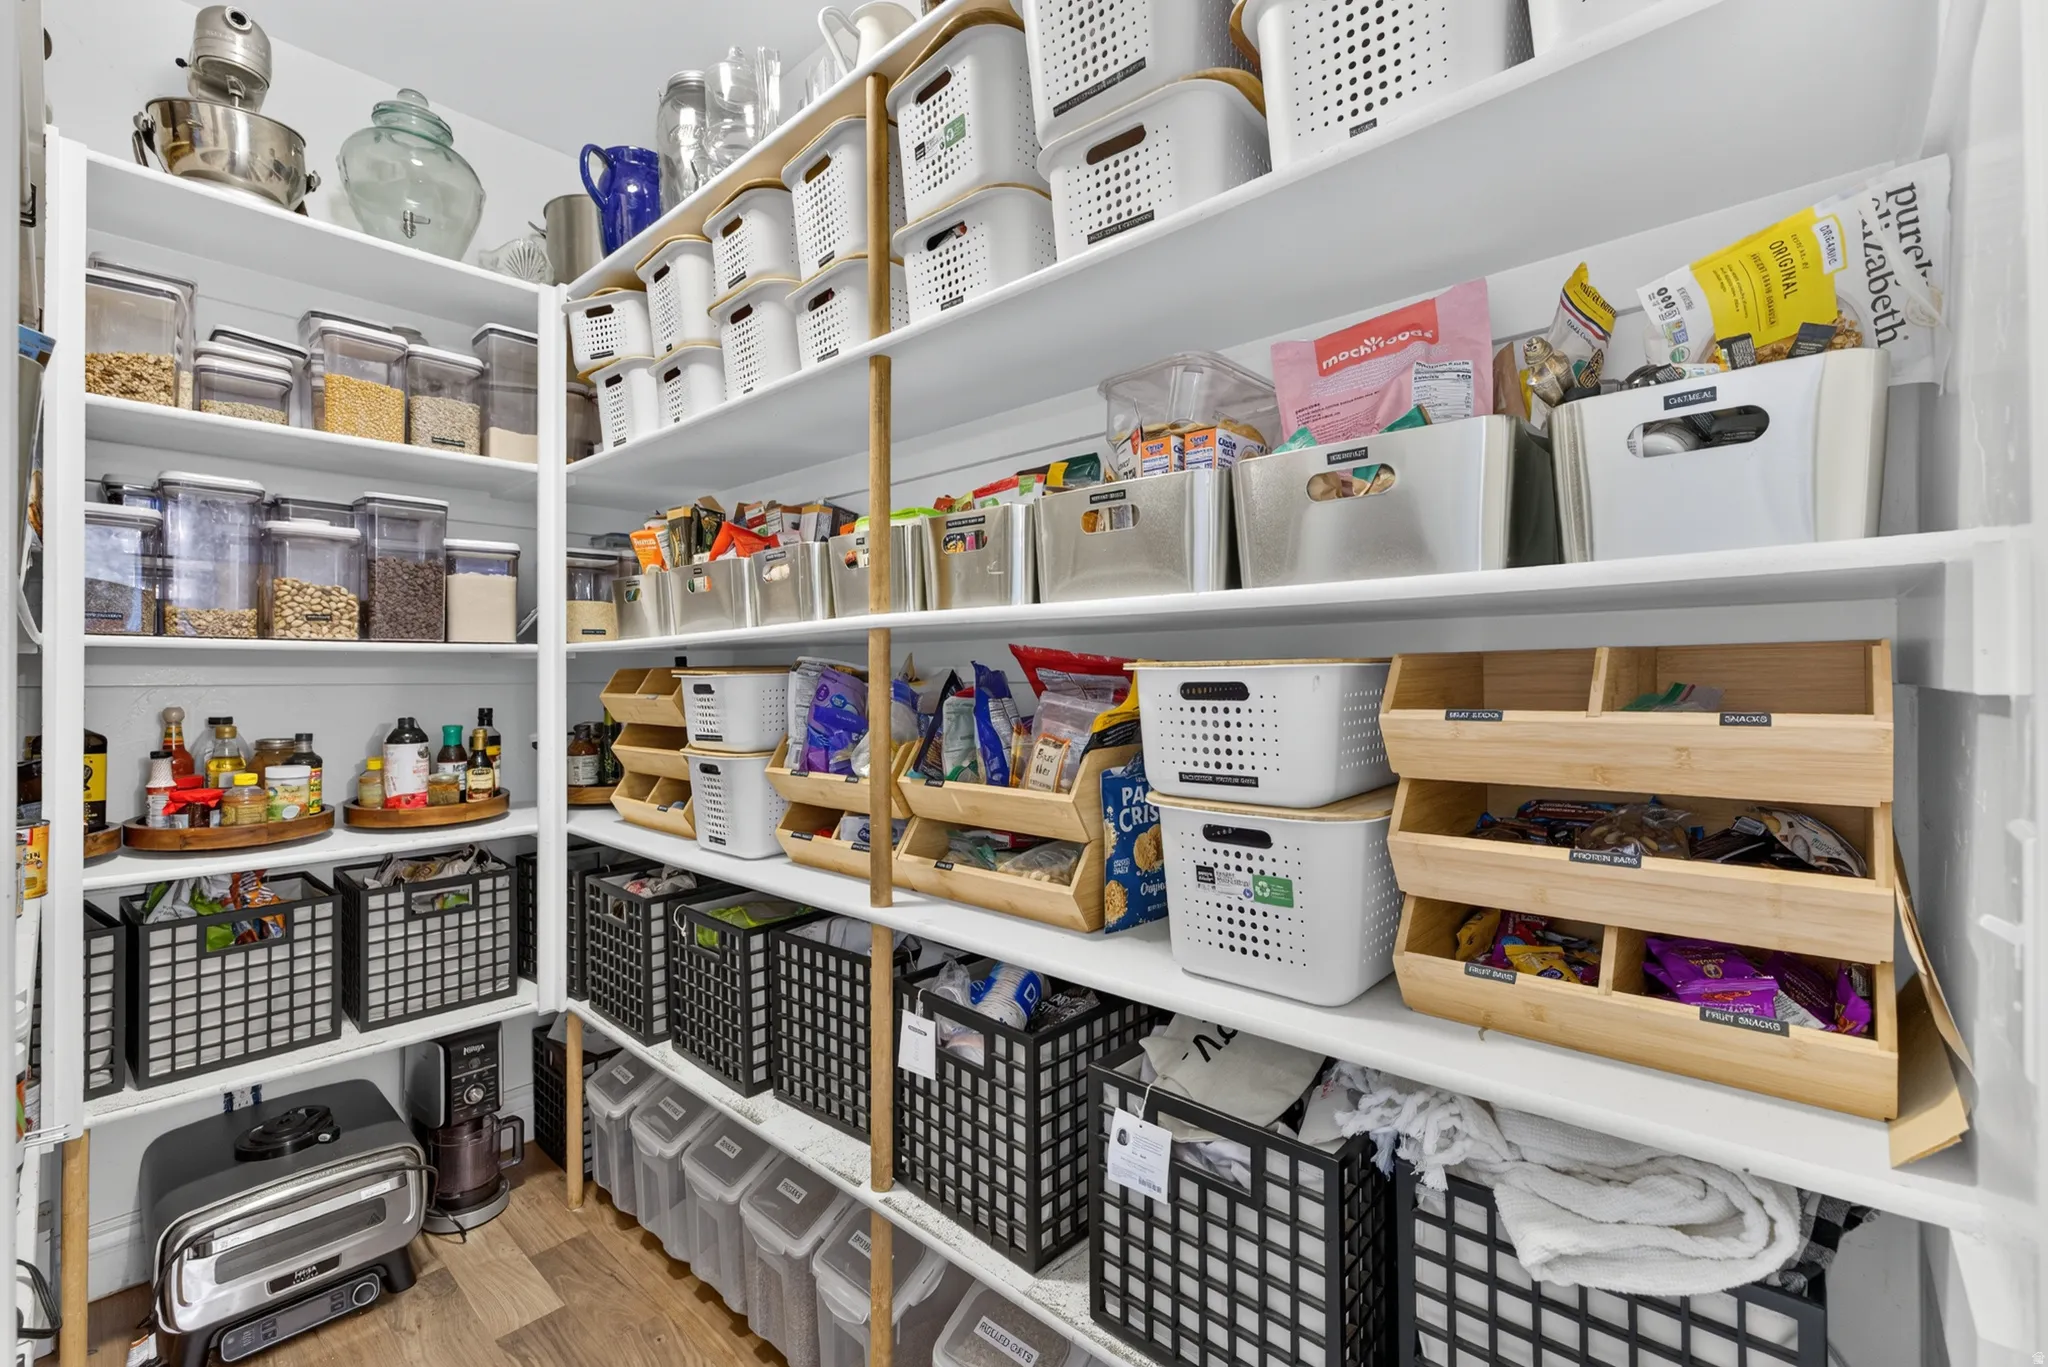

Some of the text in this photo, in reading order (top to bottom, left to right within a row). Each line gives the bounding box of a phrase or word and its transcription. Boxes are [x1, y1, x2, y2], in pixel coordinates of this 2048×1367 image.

[1769, 240, 1798, 299] ORIGINAL
[1668, 390, 1714, 405] OATMEAL
[1724, 715, 1768, 723] SNACKS
[1121, 785, 1145, 806] PA
[1119, 806, 1159, 832] CRIS
[1573, 852, 1611, 862] PROTEIN
[1705, 1009, 1781, 1031] FRUIT SNACKS
[980, 1321, 1034, 1363] ROLLED OATS
